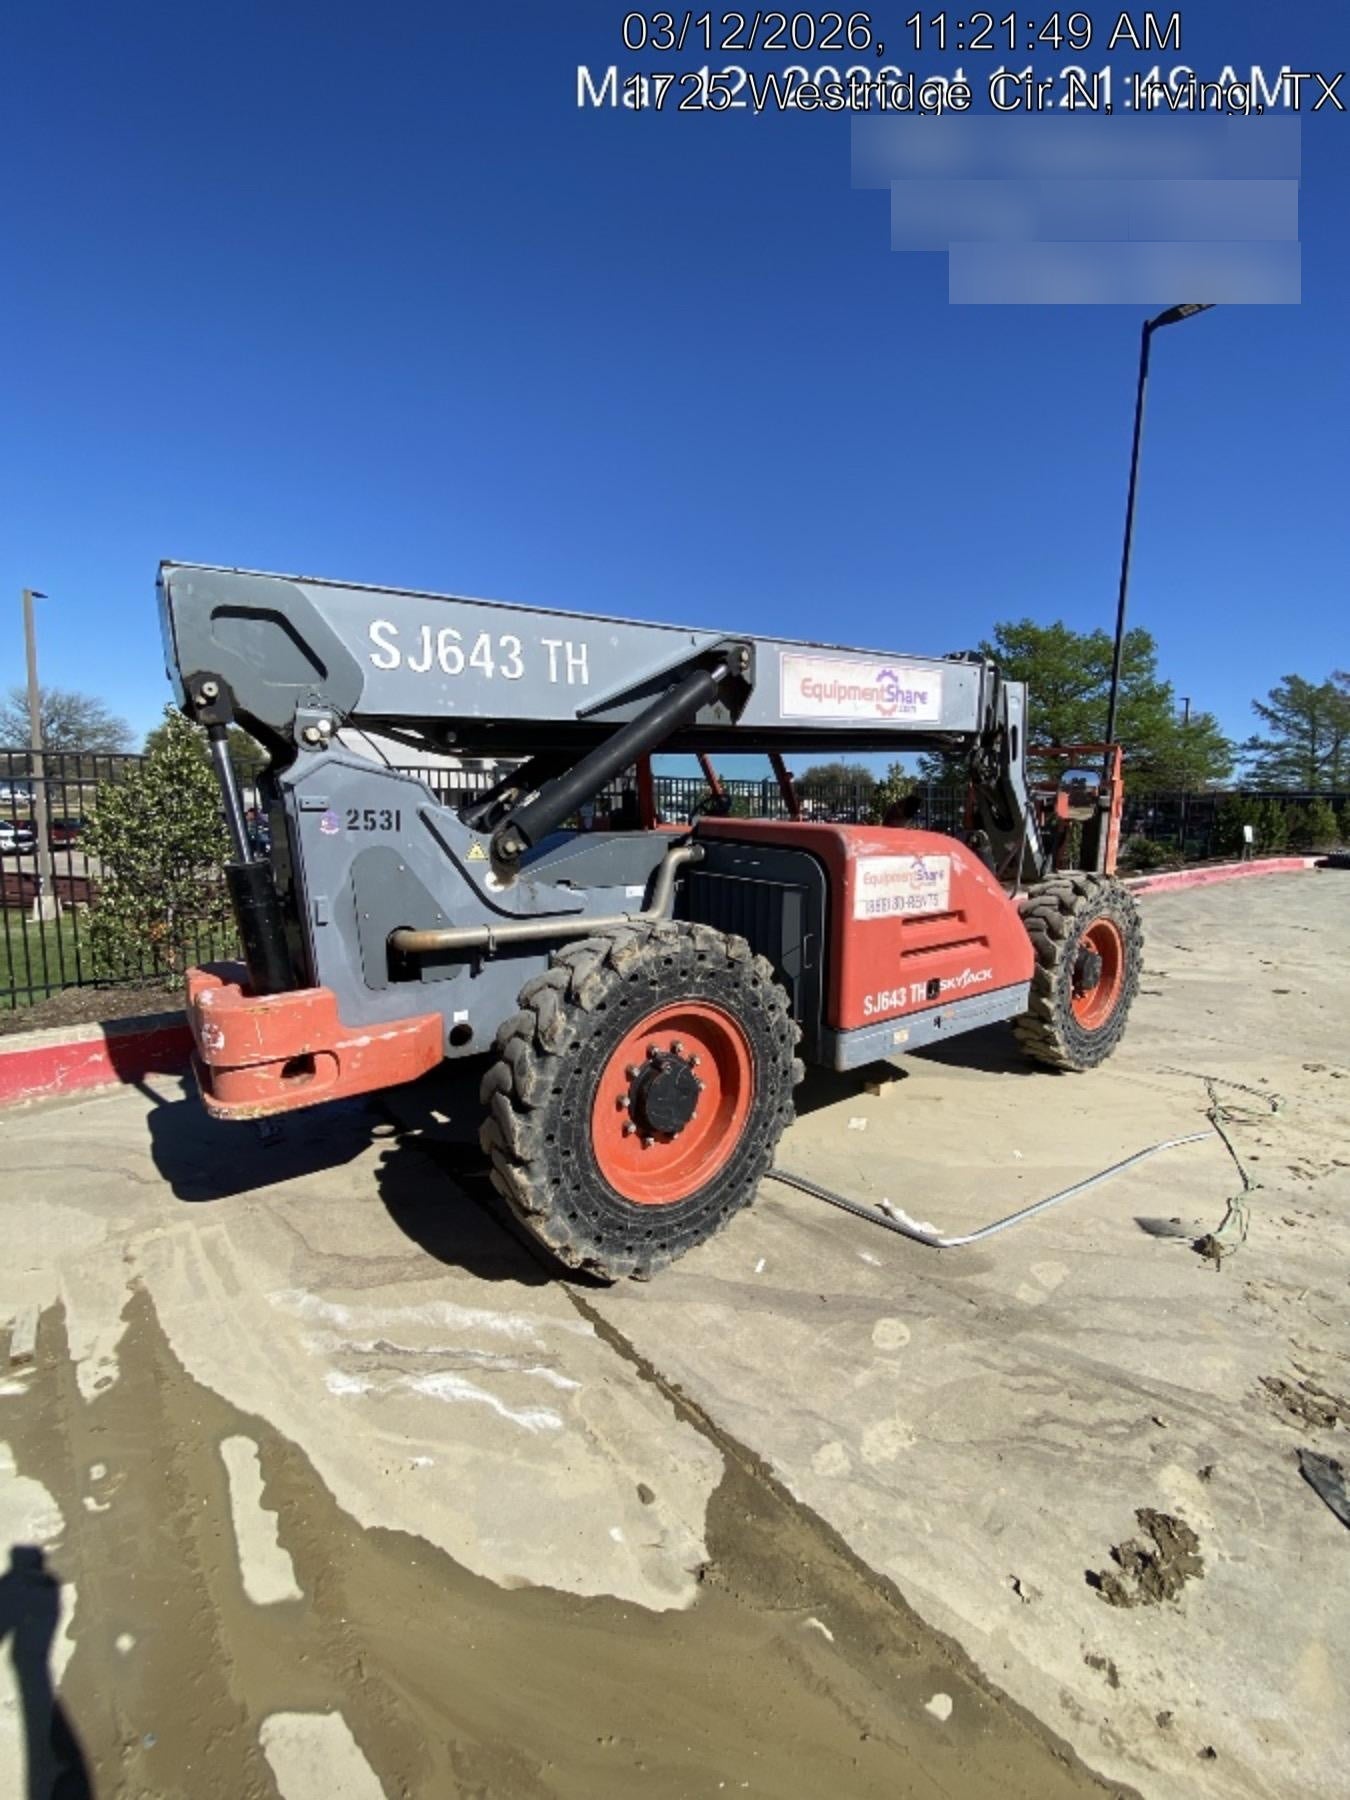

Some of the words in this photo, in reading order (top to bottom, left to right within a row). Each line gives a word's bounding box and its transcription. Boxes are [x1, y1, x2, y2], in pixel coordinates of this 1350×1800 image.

[368, 619, 526, 681] SJ643
[541, 637, 591, 686] TH
[345, 808, 401, 832] 2531
[863, 986, 907, 1017] SJ643
[909, 981, 928, 1004] TH
